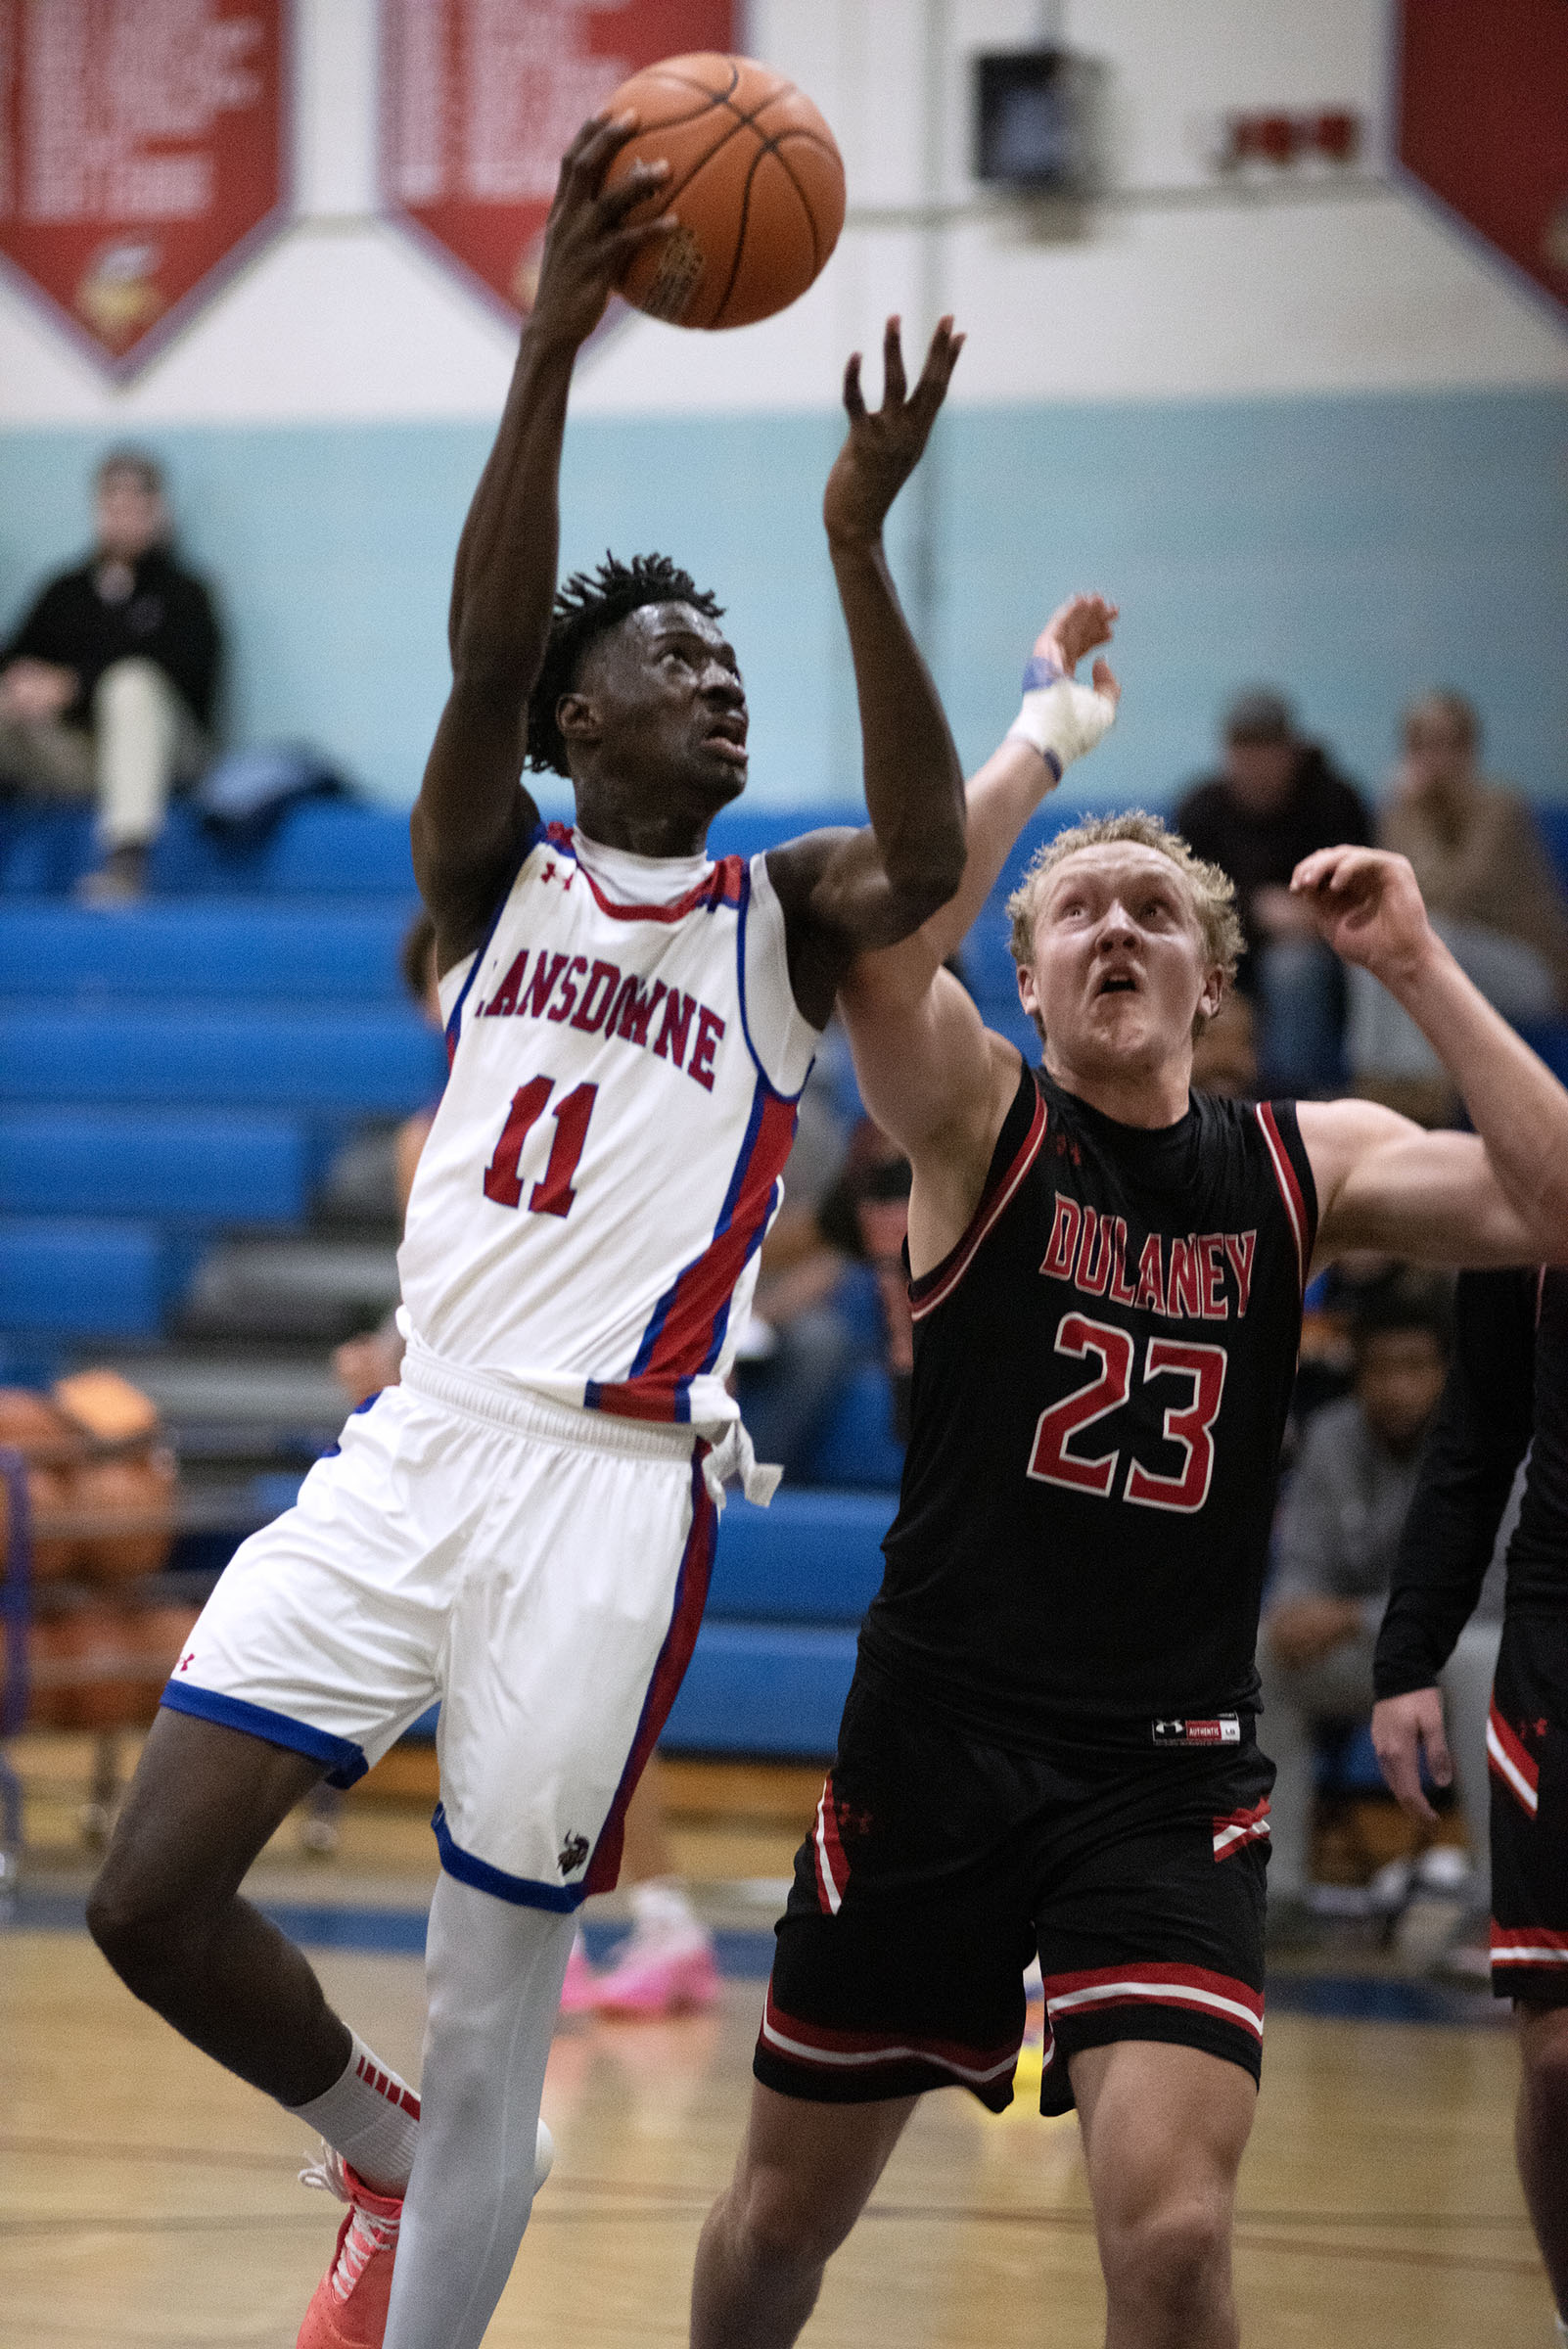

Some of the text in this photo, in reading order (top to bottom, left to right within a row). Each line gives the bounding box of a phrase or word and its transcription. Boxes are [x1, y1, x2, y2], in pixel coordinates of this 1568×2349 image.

[476, 949, 726, 1092] ANSDOWNE
[484, 1075, 598, 1218] 11
[1039, 1191, 1257, 1319] DULANEY
[1028, 1313, 1227, 1513] 23
